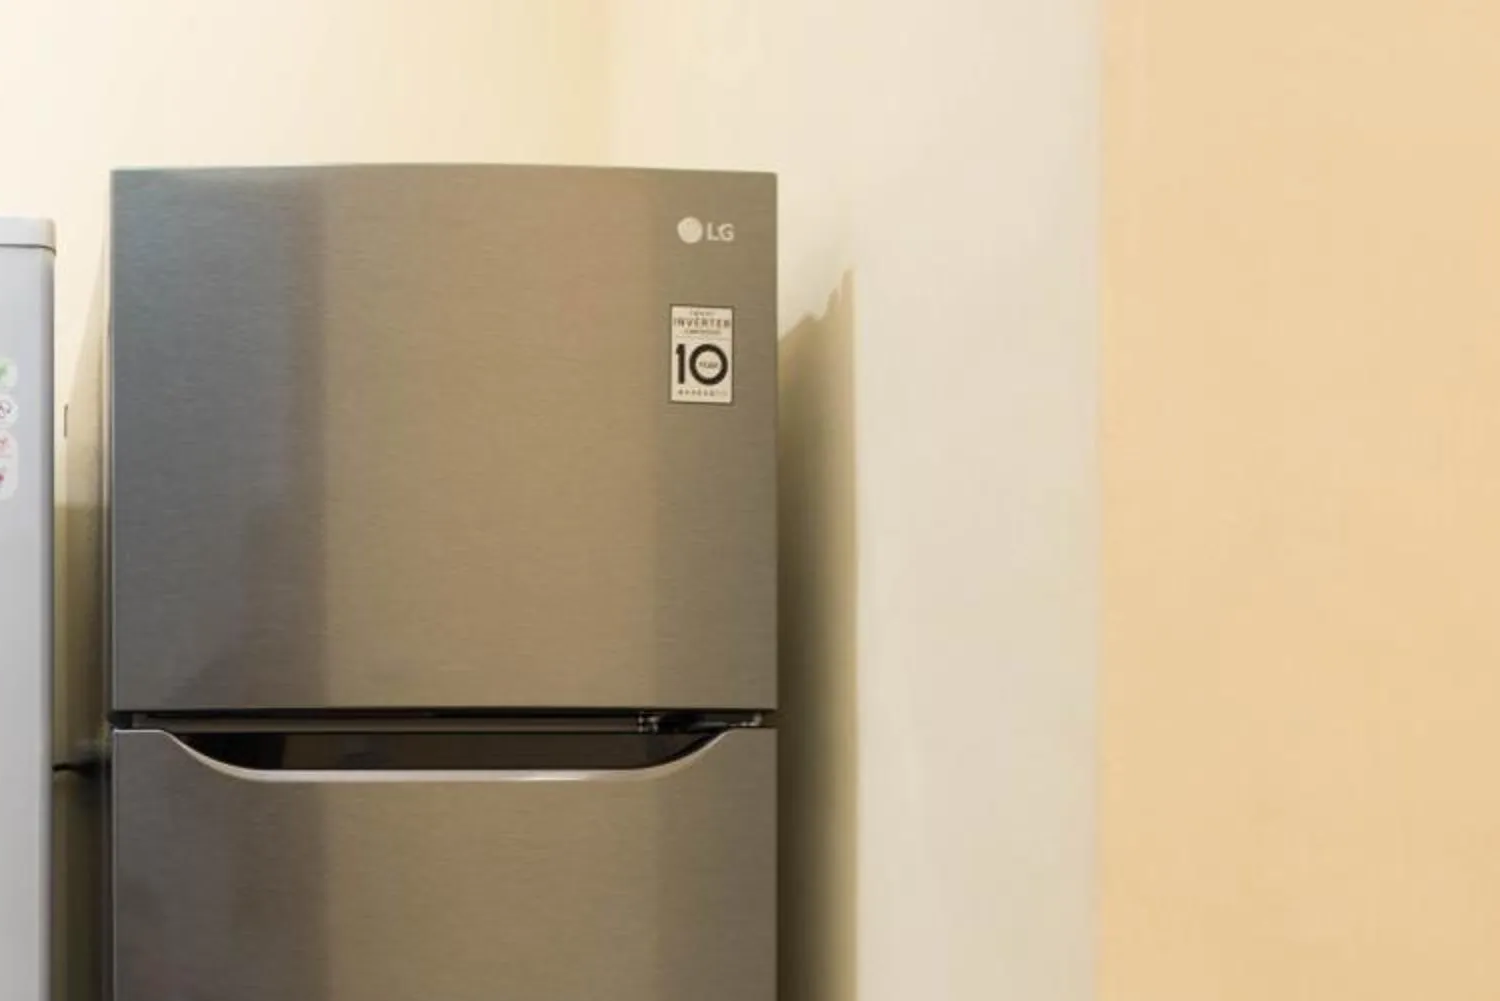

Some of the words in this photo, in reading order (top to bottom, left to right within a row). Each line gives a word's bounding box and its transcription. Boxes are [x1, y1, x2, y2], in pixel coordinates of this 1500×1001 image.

[706, 222, 735, 241] LG
[674, 319, 731, 329] INVERTER
[675, 343, 729, 386] 10
